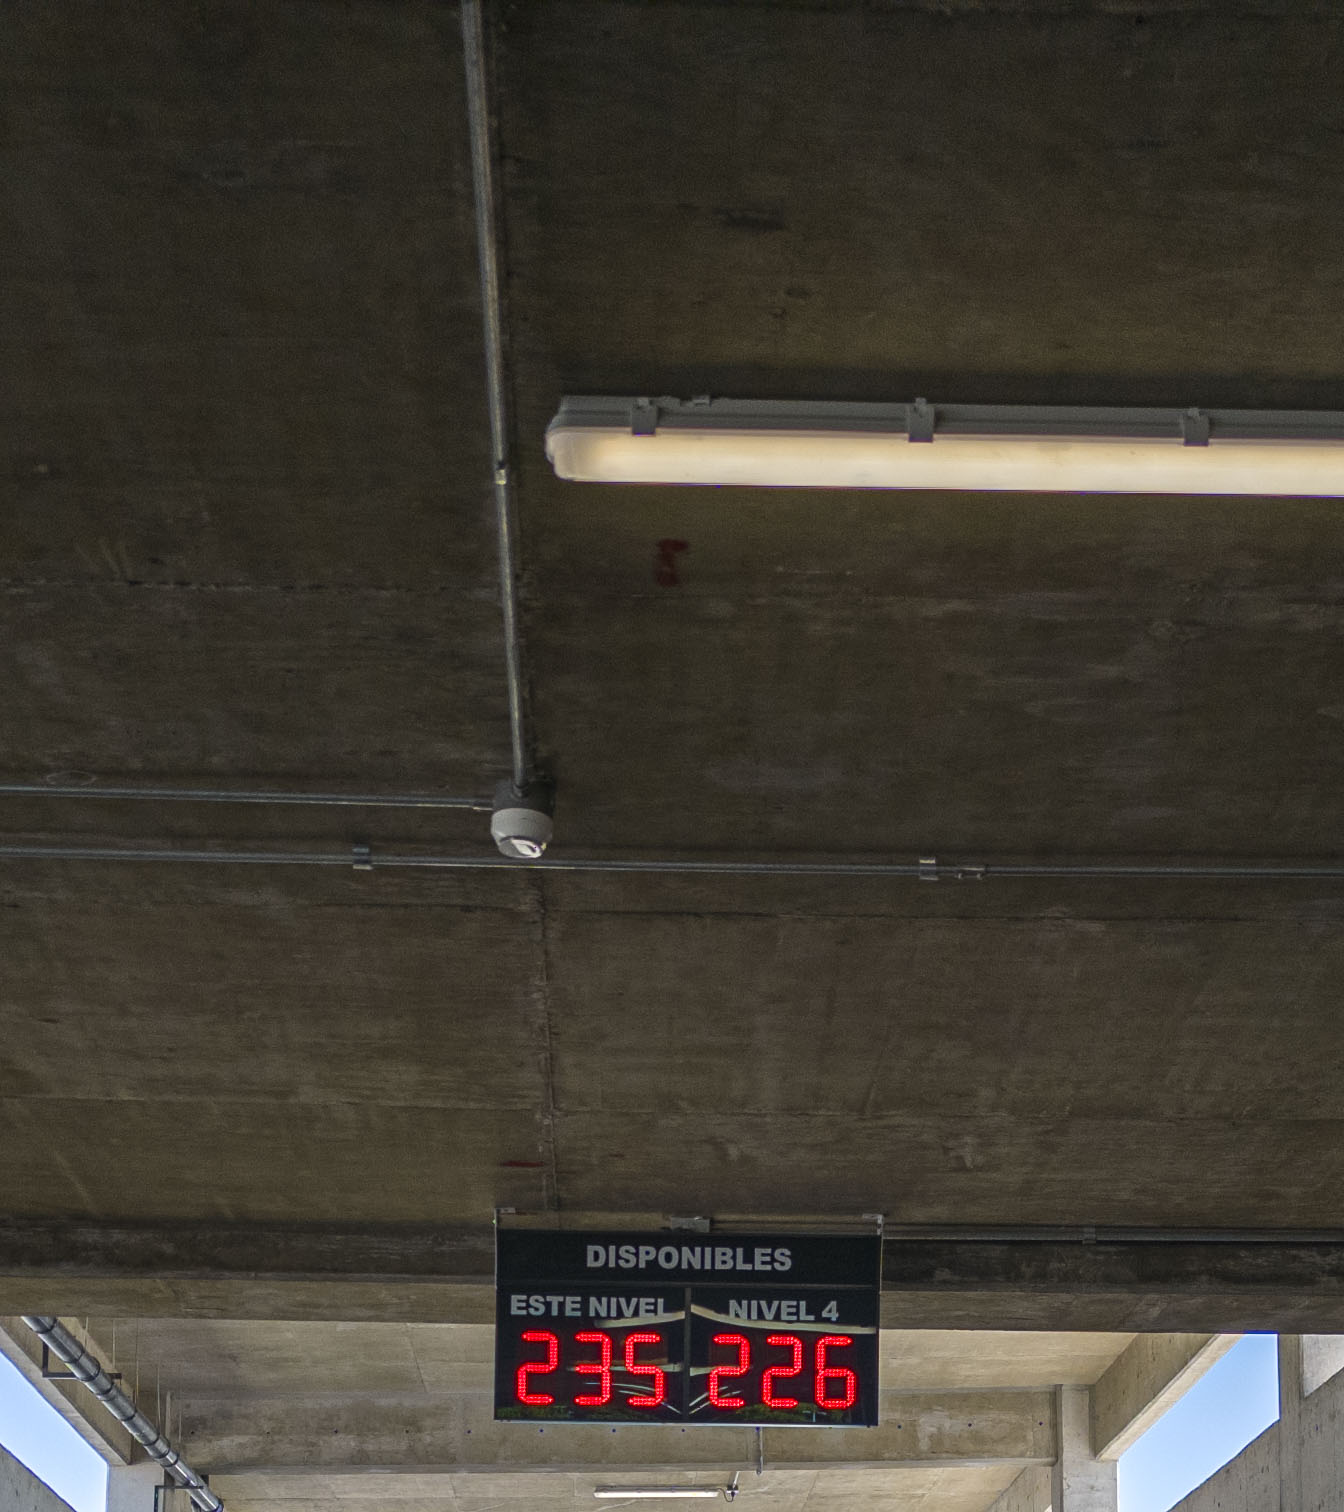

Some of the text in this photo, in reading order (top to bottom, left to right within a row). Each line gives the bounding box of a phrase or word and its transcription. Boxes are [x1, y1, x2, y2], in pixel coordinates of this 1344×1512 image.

[586, 1245, 792, 1271] DISPONIBLES
[510, 1294, 671, 1318] ESTE NIVEL
[728, 1299, 839, 1322] NIVEL 4
[515, 1329, 666, 1408] 235
[708, 1334, 857, 1411] 226
